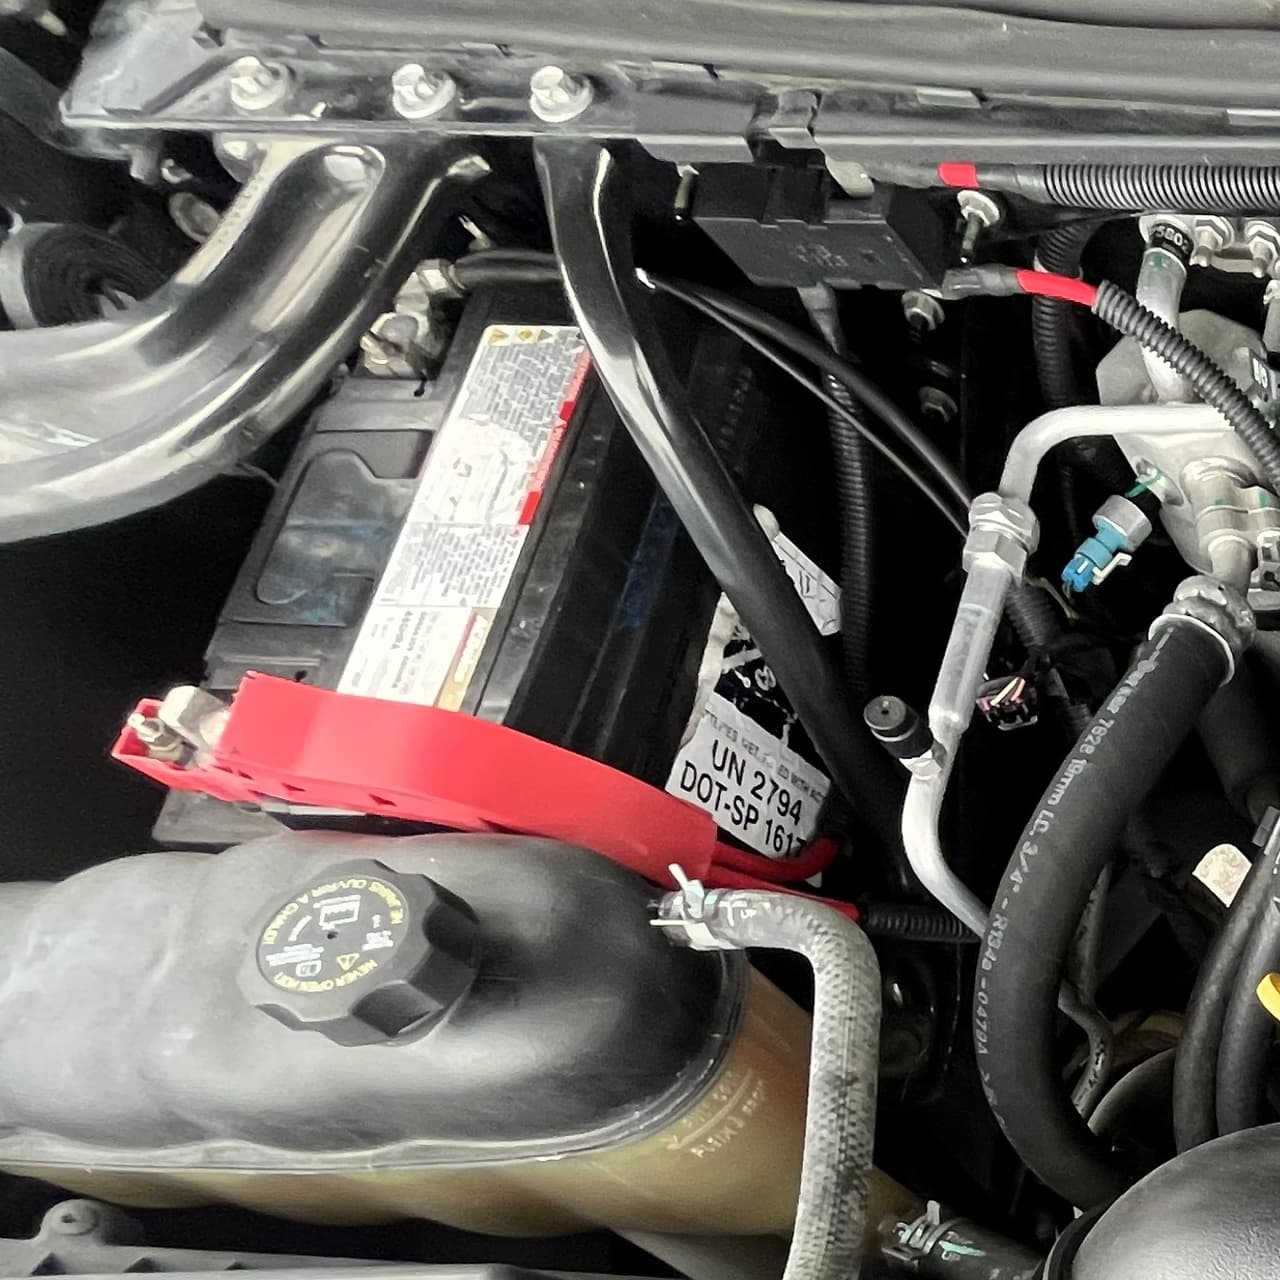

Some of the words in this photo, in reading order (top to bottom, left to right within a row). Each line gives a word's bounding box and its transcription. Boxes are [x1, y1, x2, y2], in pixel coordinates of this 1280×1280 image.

[680, 761, 759, 831] DOT-SP
[712, 739, 746, 786] UN
[750, 771, 802, 826] 2794
[335, 960, 378, 986] NEVER
